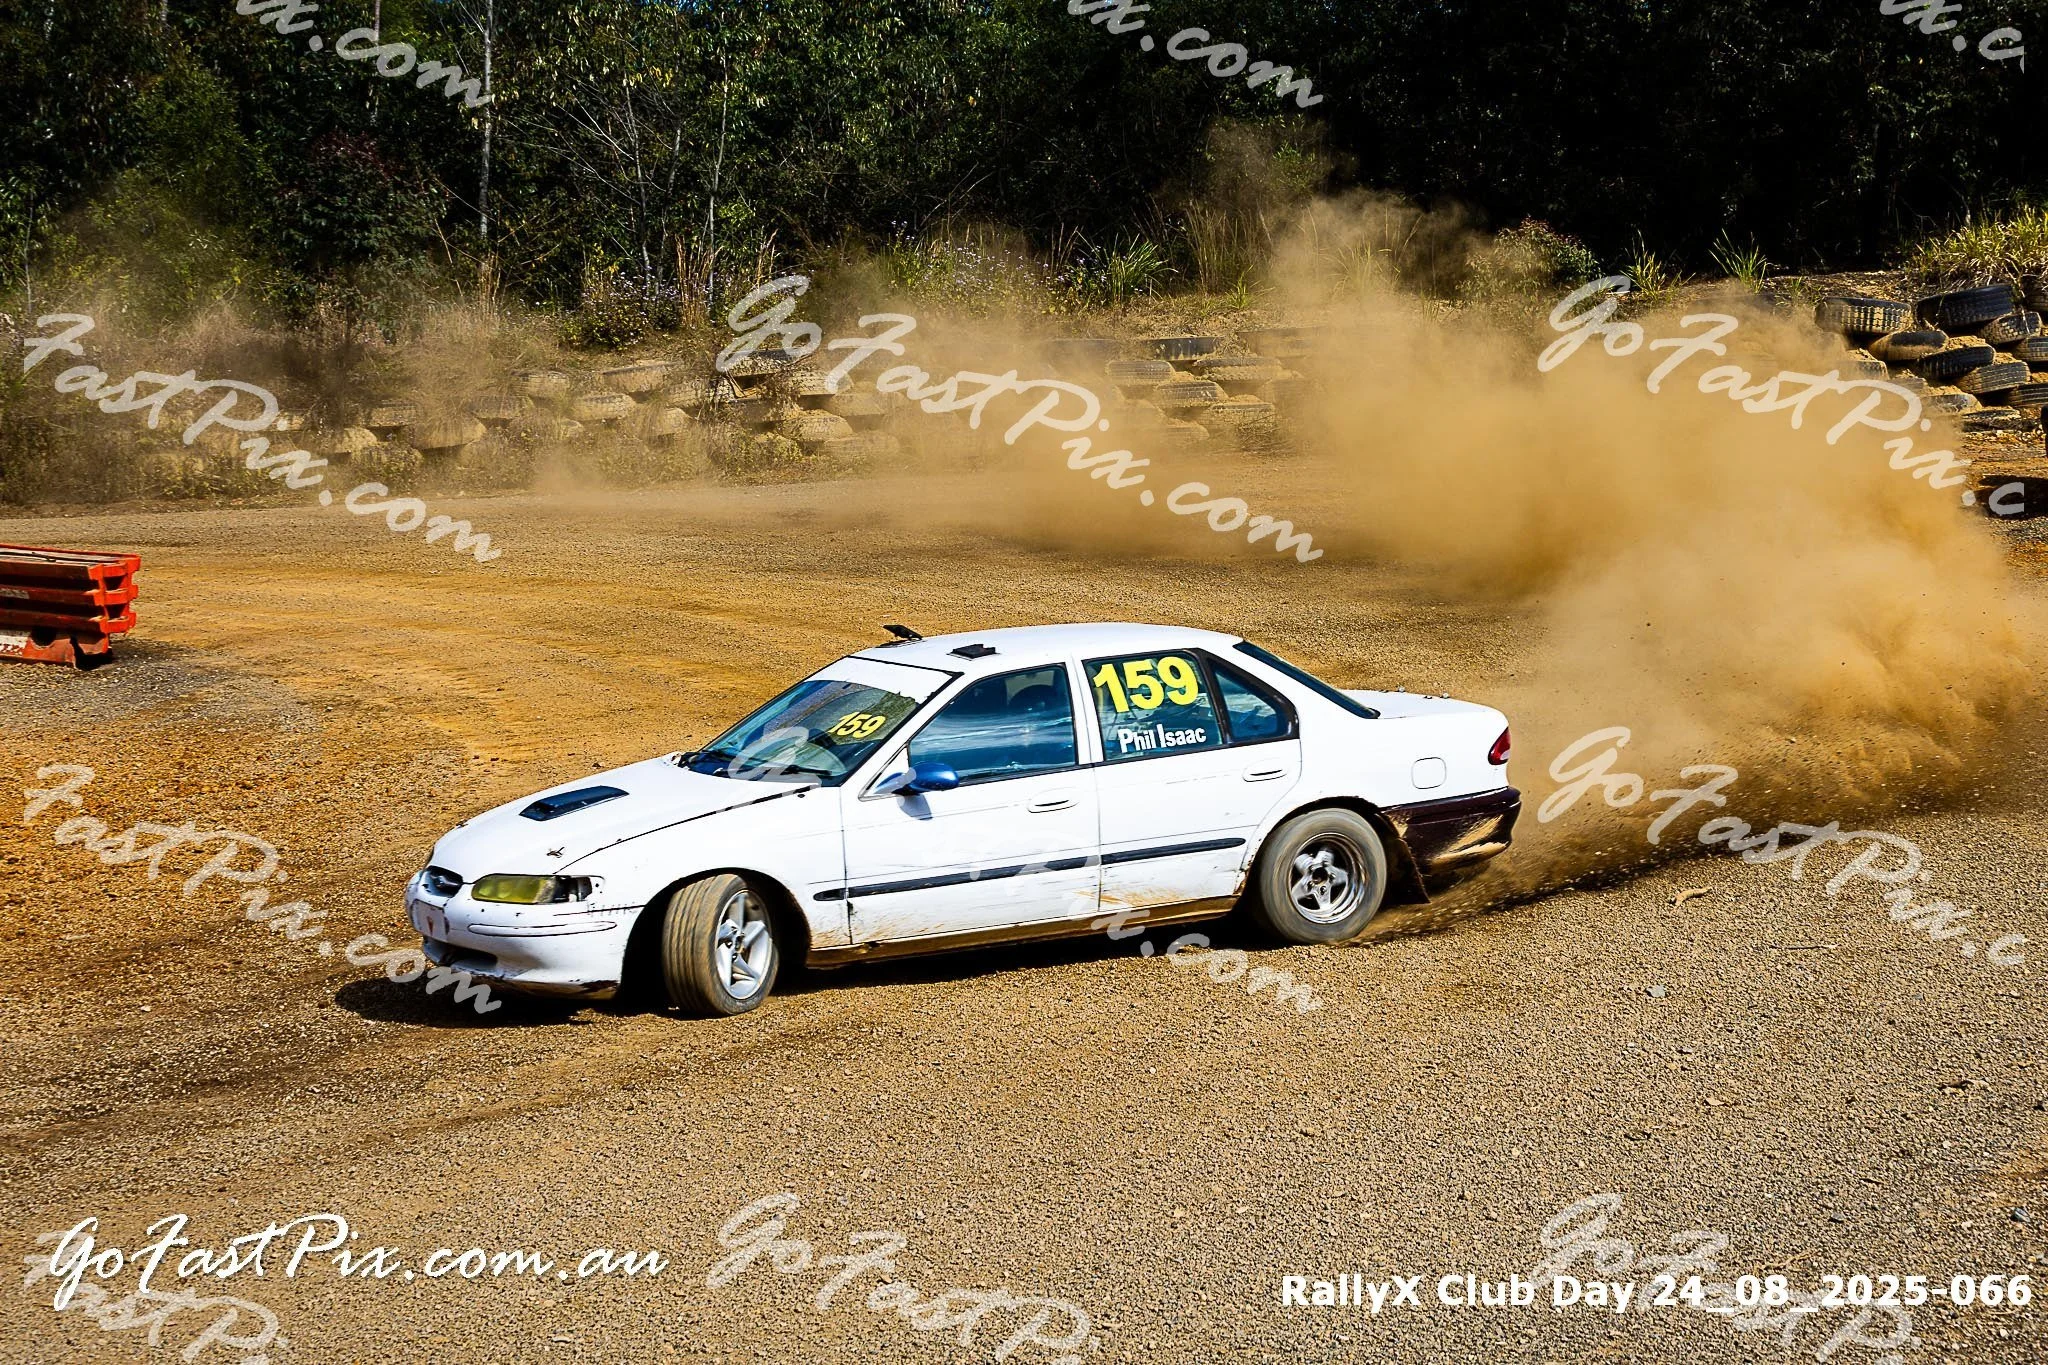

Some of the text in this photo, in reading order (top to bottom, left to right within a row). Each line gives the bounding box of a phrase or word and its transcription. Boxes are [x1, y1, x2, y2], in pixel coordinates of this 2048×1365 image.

[1093, 656, 1199, 713] 159
[827, 711, 886, 738] 159
[1118, 723, 1206, 753] Phil Isaac
